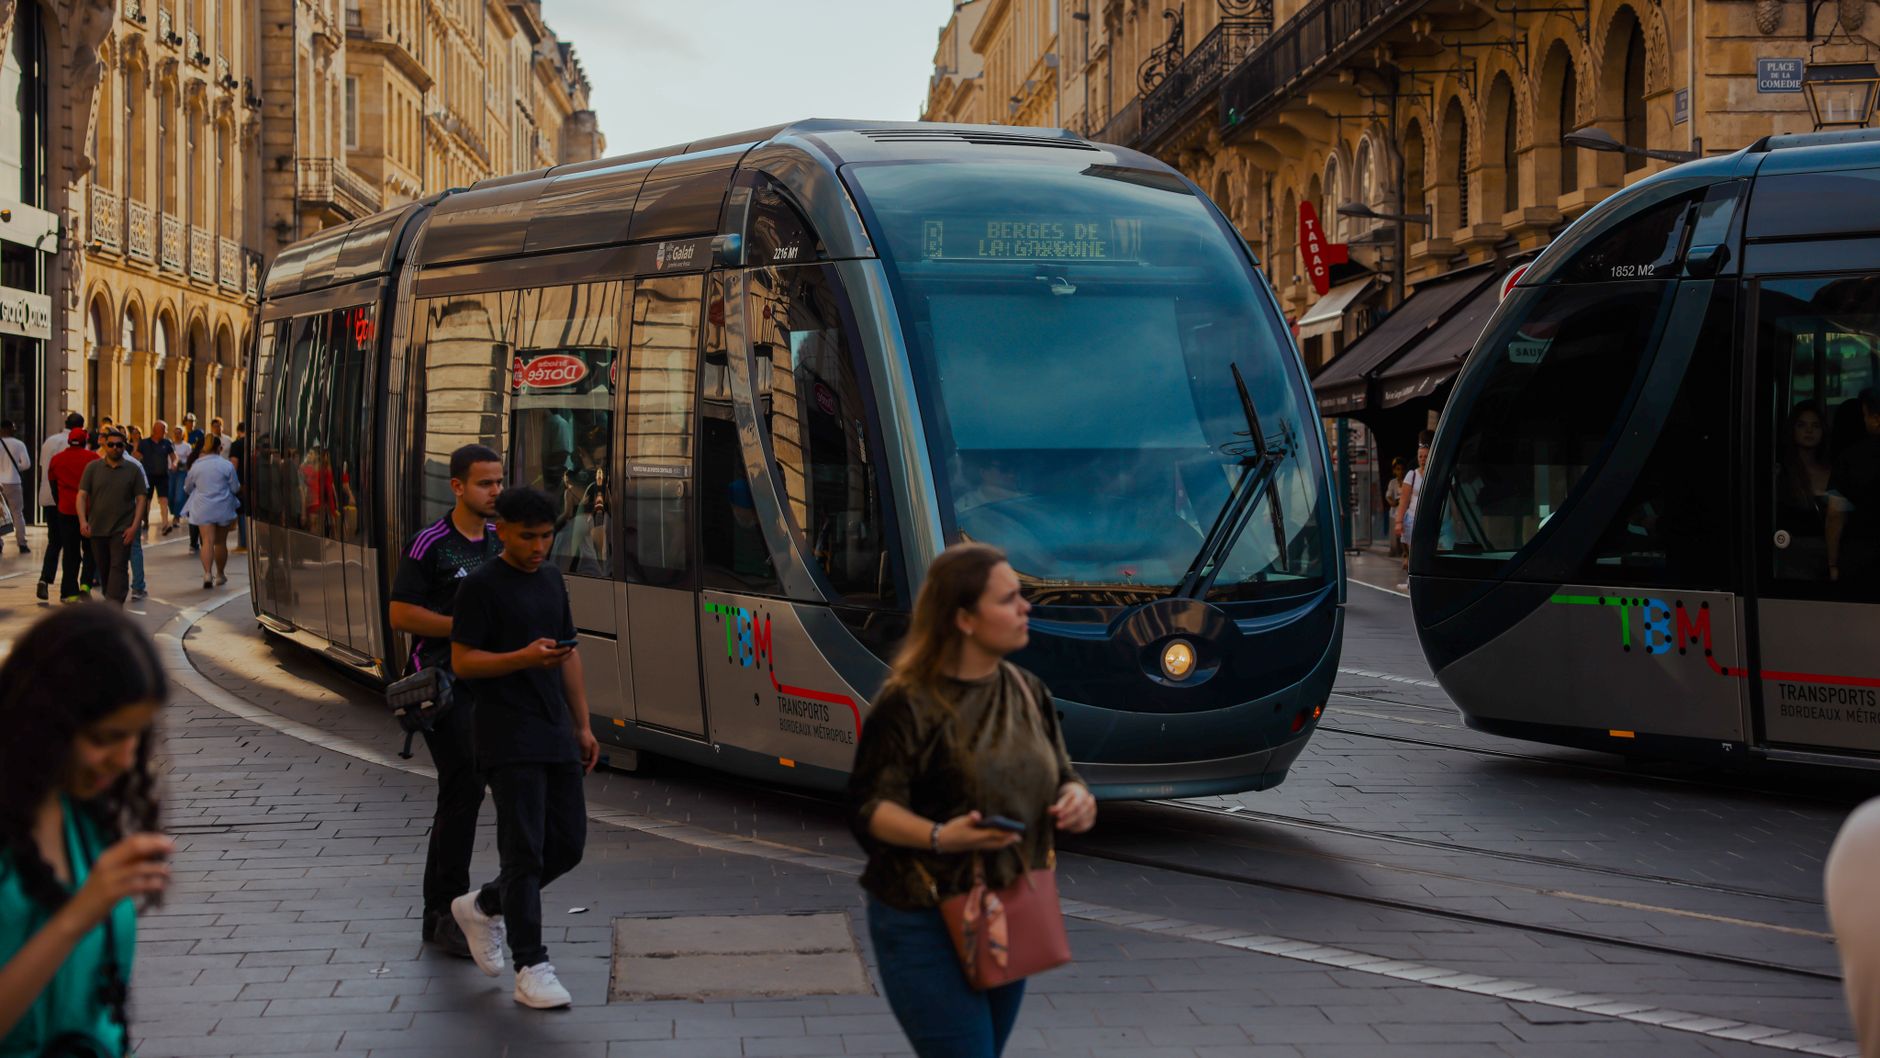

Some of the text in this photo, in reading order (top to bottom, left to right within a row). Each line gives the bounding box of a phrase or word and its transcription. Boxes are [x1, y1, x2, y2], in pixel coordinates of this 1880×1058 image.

[1768, 62, 1794, 72] PLACE
[987, 221, 1099, 240] BERGES DE
[673, 244, 695, 261] Galati
[773, 246, 799, 260] 2216 M1
[1304, 219, 1325, 277] TABAC
[1610, 264, 1656, 278] 1852 M2
[704, 602, 774, 668] TBM
[1590, 594, 1711, 655] TBM
[1778, 683, 1876, 707] TRANSPORTS
[776, 695, 830, 723] TRANSPORTS
[1780, 704, 1841, 721] BORDEAUX
[779, 717, 854, 745] BORDEAUX MÉTROPOLE
